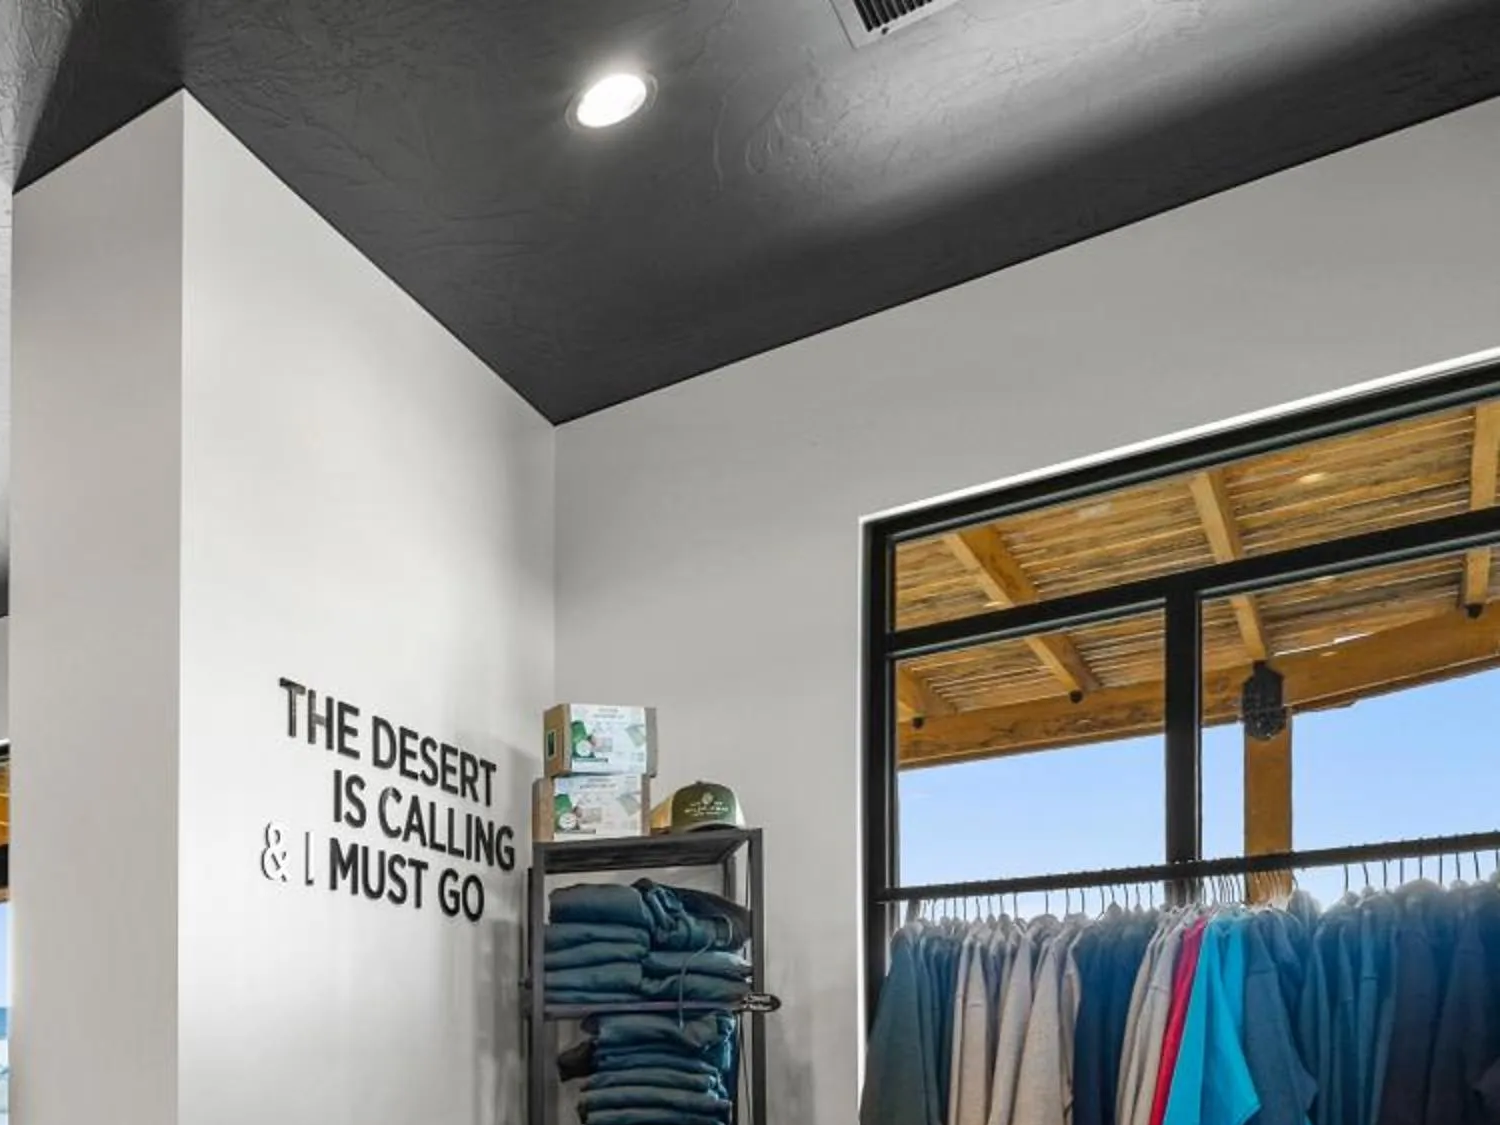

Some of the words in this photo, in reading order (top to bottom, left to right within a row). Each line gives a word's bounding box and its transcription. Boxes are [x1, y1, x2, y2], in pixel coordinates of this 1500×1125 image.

[279, 677, 361, 759] THE
[372, 715, 497, 807] DESERT
[333, 769, 367, 829] IS
[378, 787, 515, 871] CALLING
[260, 822, 290, 883] &
[329, 837, 428, 909] MUST
[438, 868, 485, 922] GO
